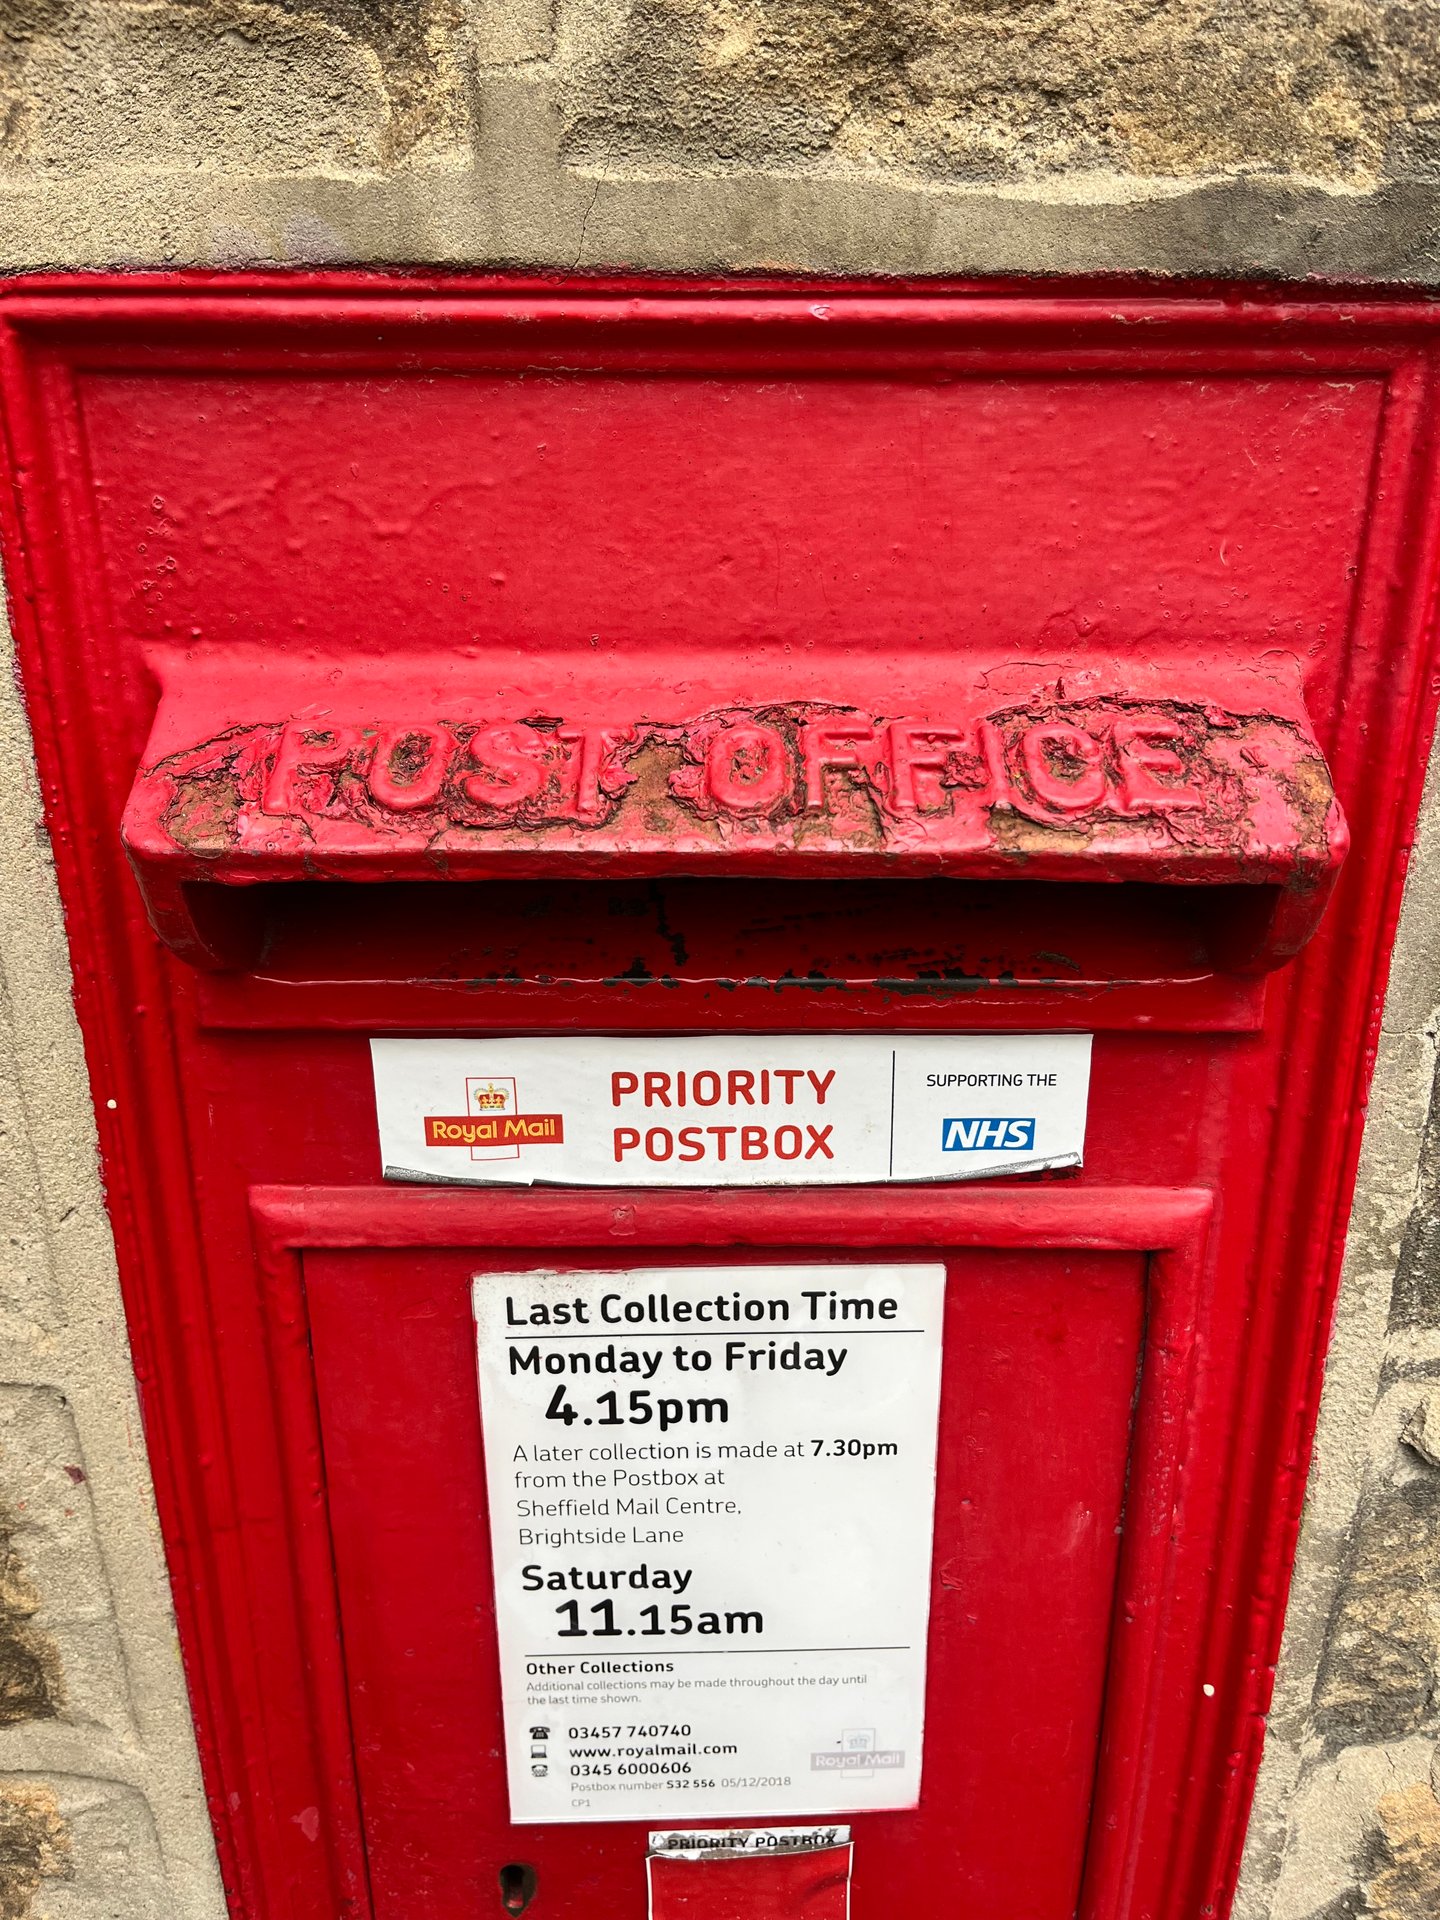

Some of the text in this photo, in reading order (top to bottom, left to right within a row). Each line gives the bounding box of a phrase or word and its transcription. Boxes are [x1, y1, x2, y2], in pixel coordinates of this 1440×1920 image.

[262, 718, 1208, 814] POST OFFICE
[610, 1068, 836, 1107] PRIORITY
[927, 1074, 1057, 1086] SUPPORTING THE
[432, 1118, 557, 1143] Royal Mail
[945, 1119, 1032, 1150] NHS
[613, 1124, 835, 1163] POSTBOX
[506, 1291, 897, 1325] Last Collection Time
[509, 1341, 847, 1381] Monday to Friday
[545, 1384, 728, 1432] 4.15pm
[513, 1439, 897, 1462] A later collection is made at 7.30pm
[515, 1469, 725, 1488] from the Postbox at
[517, 1497, 741, 1516] Sheffield Mail Centre,
[520, 1527, 683, 1548] Brightside Lane
[522, 1564, 692, 1594] Saturday
[556, 1599, 762, 1636] 11.15am
[527, 1661, 673, 1675] Other Collections
[527, 1675, 867, 1691] Additional collections may be made throughout the day until
[528, 1694, 641, 1704] the last time shown.
[569, 1725, 690, 1739] 03457 740740
[570, 1744, 737, 1758] www.royalmail.com
[571, 1762, 691, 1776] 0345 6000606
[815, 1754, 900, 1768] Royal Mail
[571, 1777, 791, 1791] Postbox number S32 556 05/12/2018
[572, 1799, 590, 1807] CP1
[667, 1833, 837, 1850] PRIORITY POSTBOX
